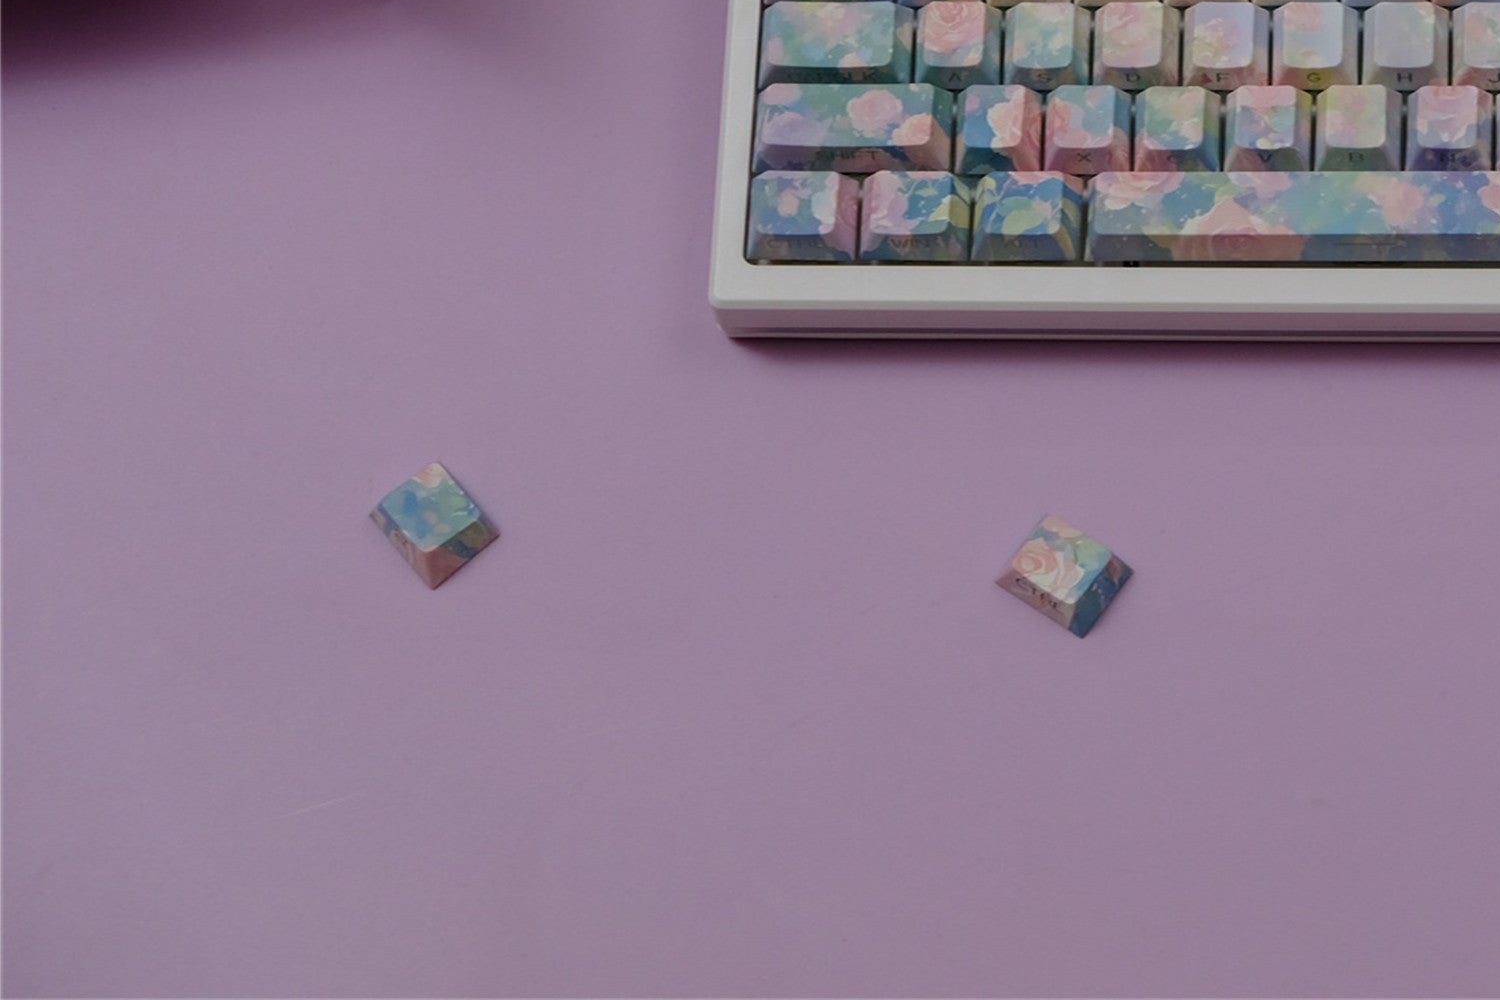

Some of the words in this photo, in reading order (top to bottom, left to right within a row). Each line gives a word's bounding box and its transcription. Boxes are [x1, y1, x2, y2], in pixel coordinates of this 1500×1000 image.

[1125, 72, 1141, 83] D
[1217, 72, 1229, 83] F
[1306, 72, 1321, 83] G
[1397, 72, 1413, 83] H
[1076, 152, 1092, 162] X
